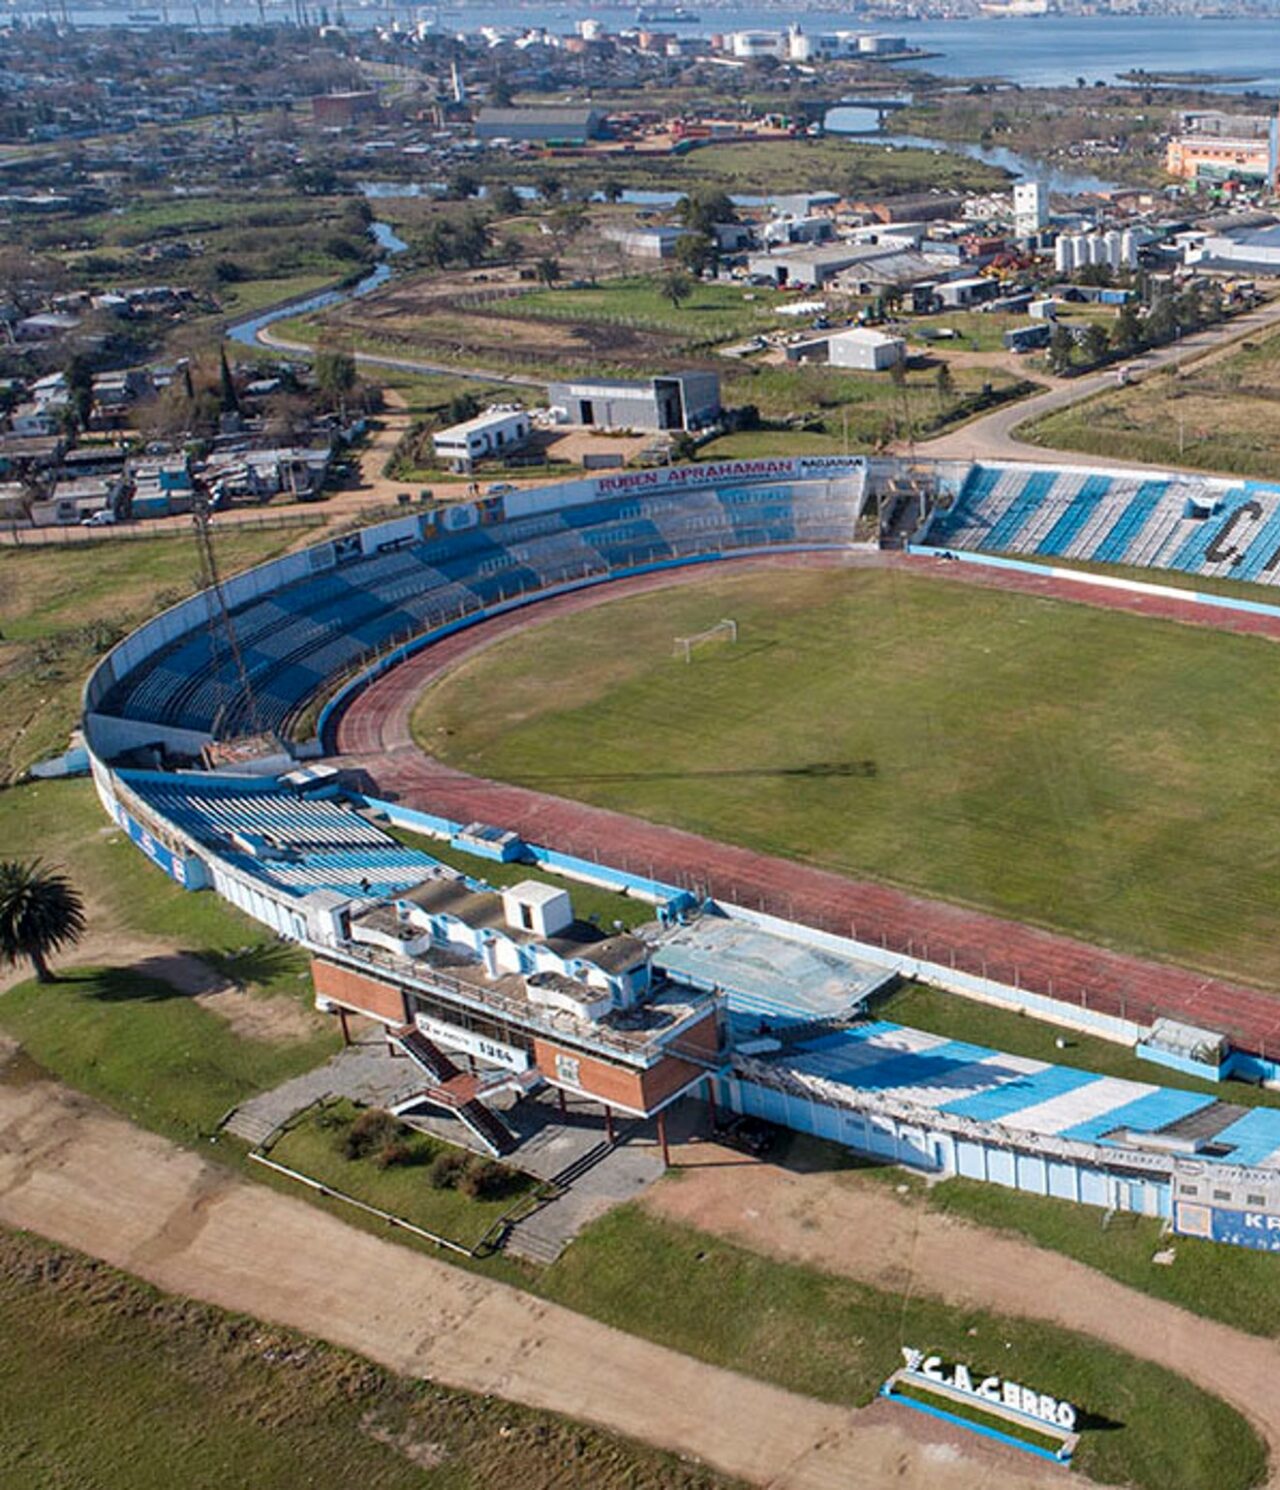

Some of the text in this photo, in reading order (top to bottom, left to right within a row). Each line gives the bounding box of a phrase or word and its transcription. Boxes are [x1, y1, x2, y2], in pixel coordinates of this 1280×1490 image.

[599, 471, 658, 491] RUBEN
[666, 459, 794, 482] APRAHAMIAN
[1204, 501, 1263, 566] C.
